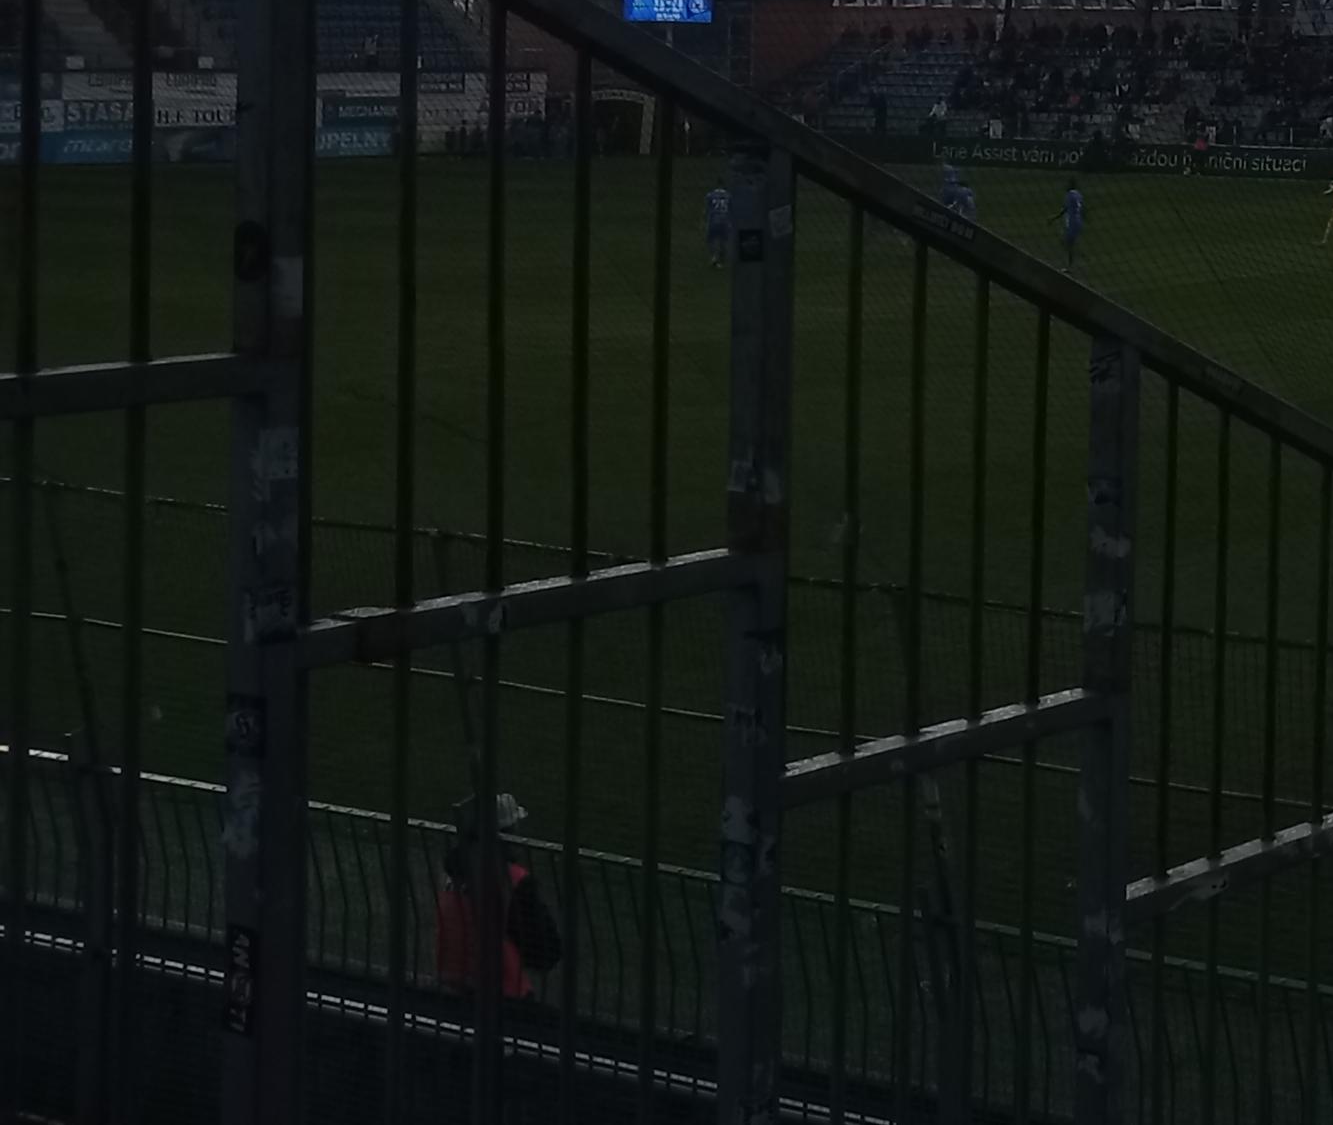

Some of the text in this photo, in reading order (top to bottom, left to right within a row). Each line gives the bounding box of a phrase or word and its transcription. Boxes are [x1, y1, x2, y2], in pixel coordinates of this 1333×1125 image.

[932, 141, 967, 159] Lane
[972, 143, 1017, 162] Assist
[1022, 146, 1054, 164] vám
[1252, 153, 1308, 174] situaci
